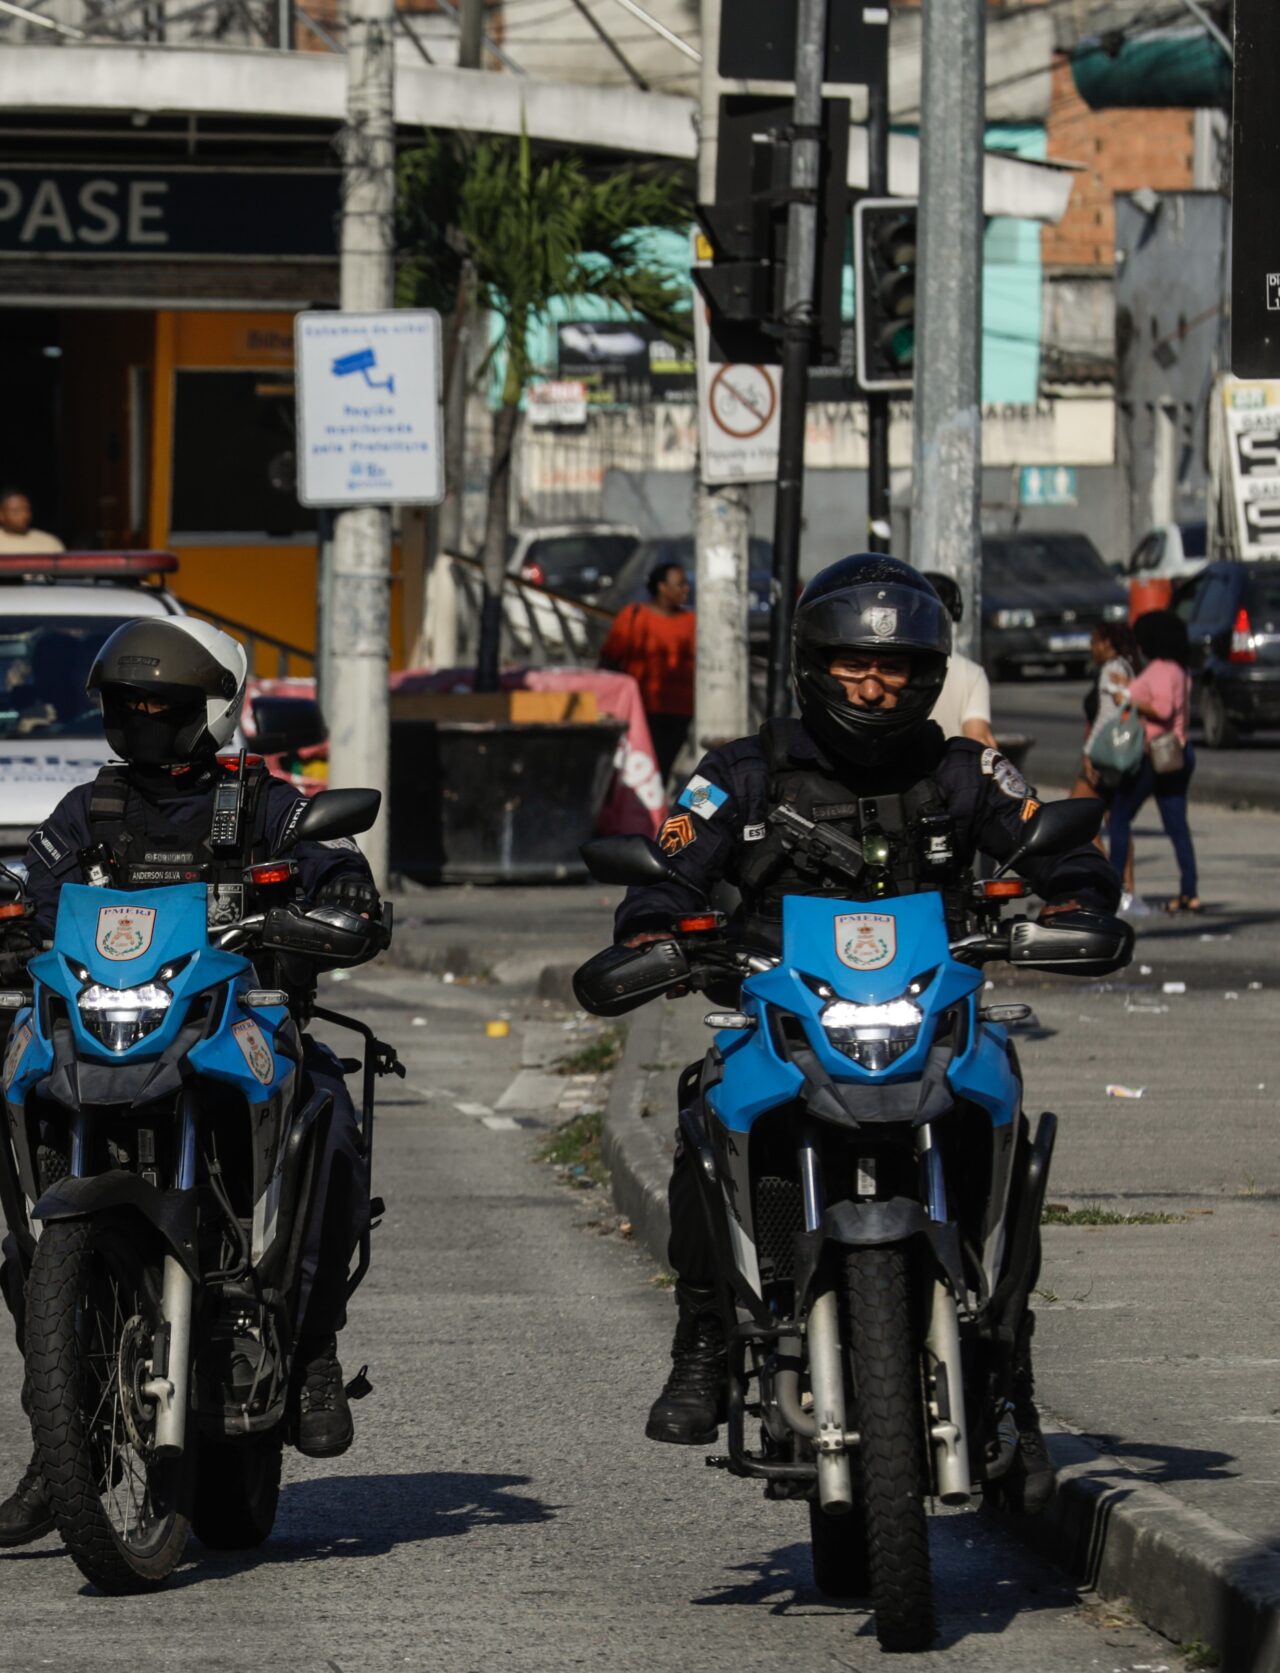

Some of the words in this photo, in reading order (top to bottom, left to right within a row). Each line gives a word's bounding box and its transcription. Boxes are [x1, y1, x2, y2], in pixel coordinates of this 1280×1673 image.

[131, 871, 163, 881] ANDERSON
[164, 871, 181, 880] SILVA
[839, 914, 891, 923] PMERJ
